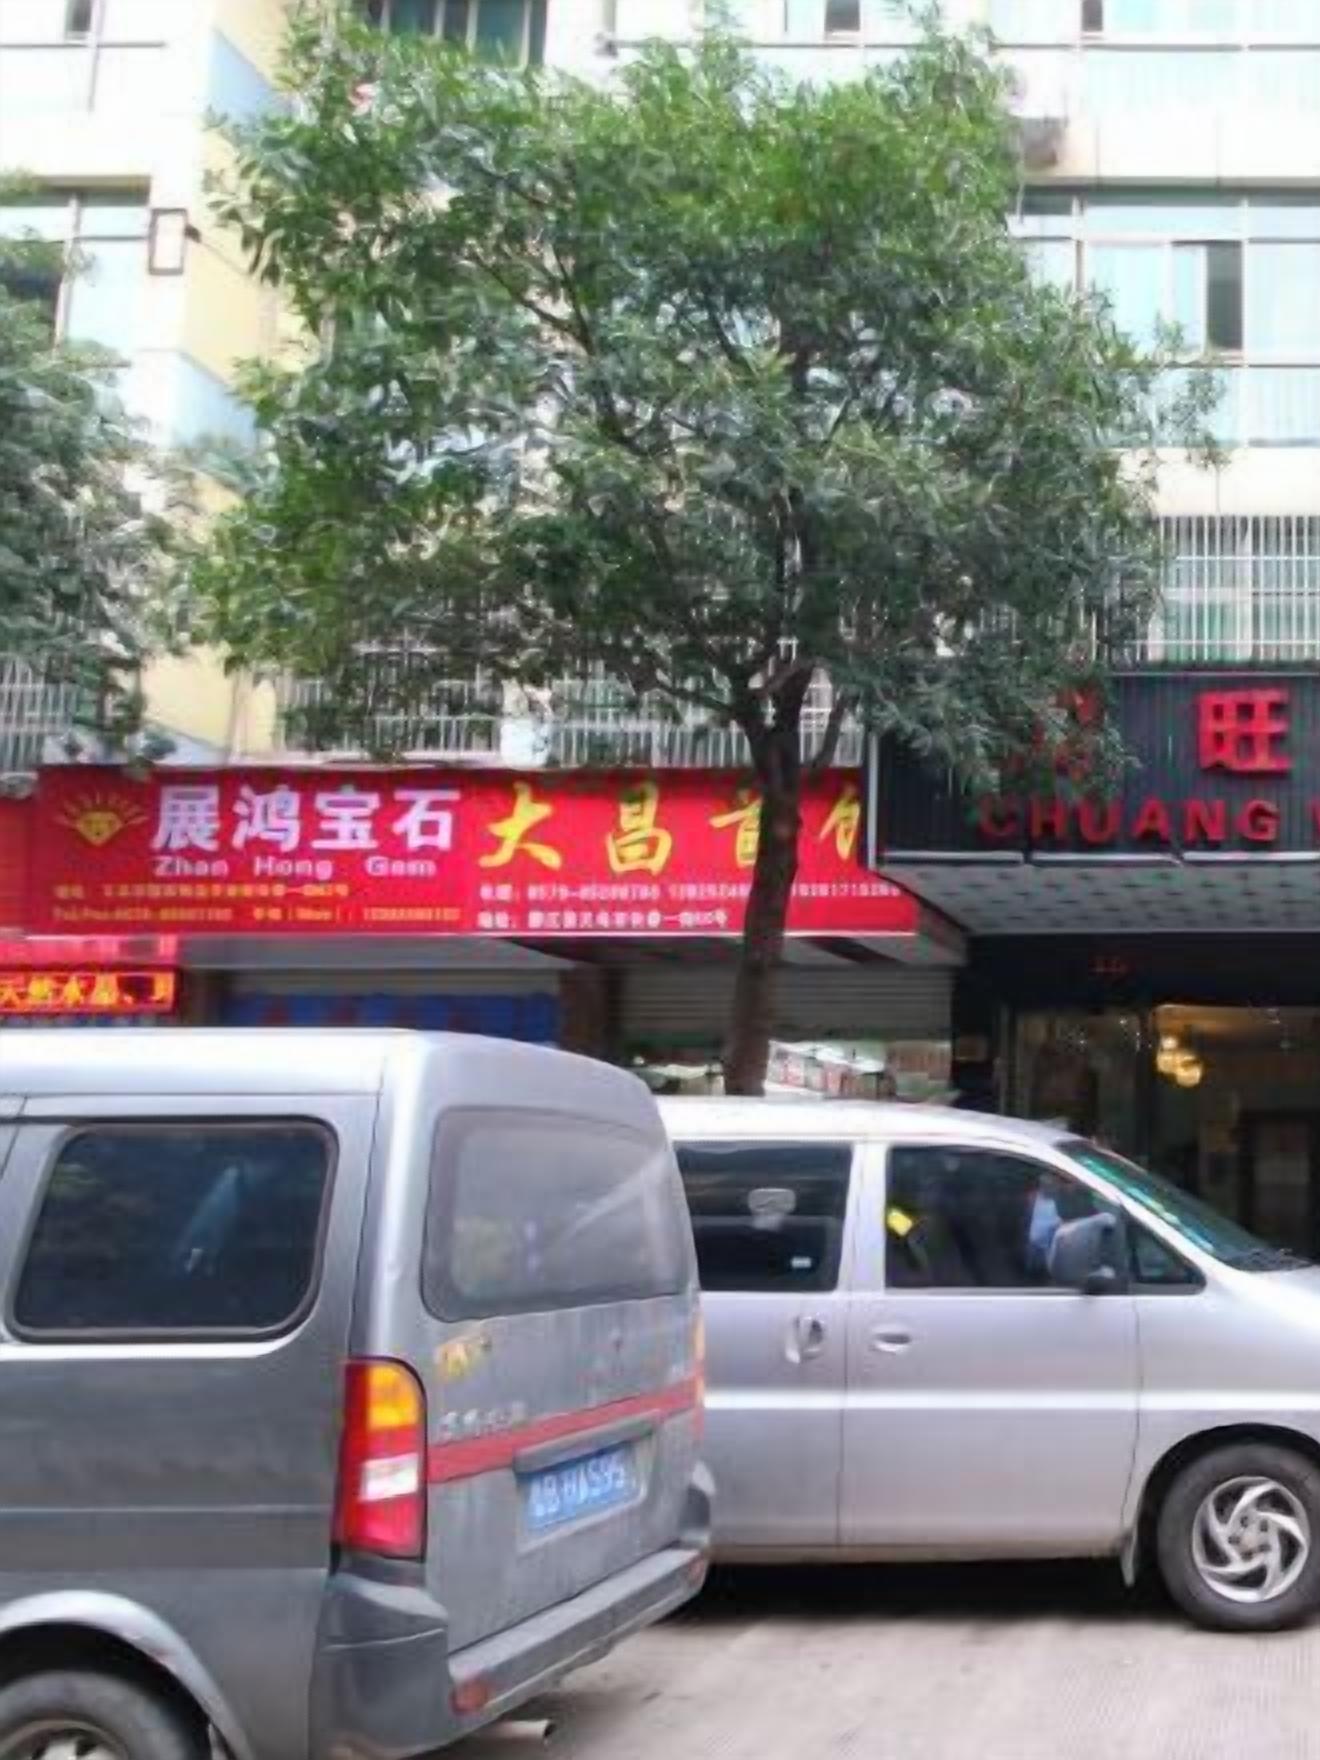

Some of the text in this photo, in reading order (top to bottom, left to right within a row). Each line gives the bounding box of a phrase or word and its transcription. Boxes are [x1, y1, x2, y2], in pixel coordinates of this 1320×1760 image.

[151, 784, 461, 852] 展鸿宝石
[976, 799, 1282, 843] CHUANG
[253, 856, 334, 880] Hong
